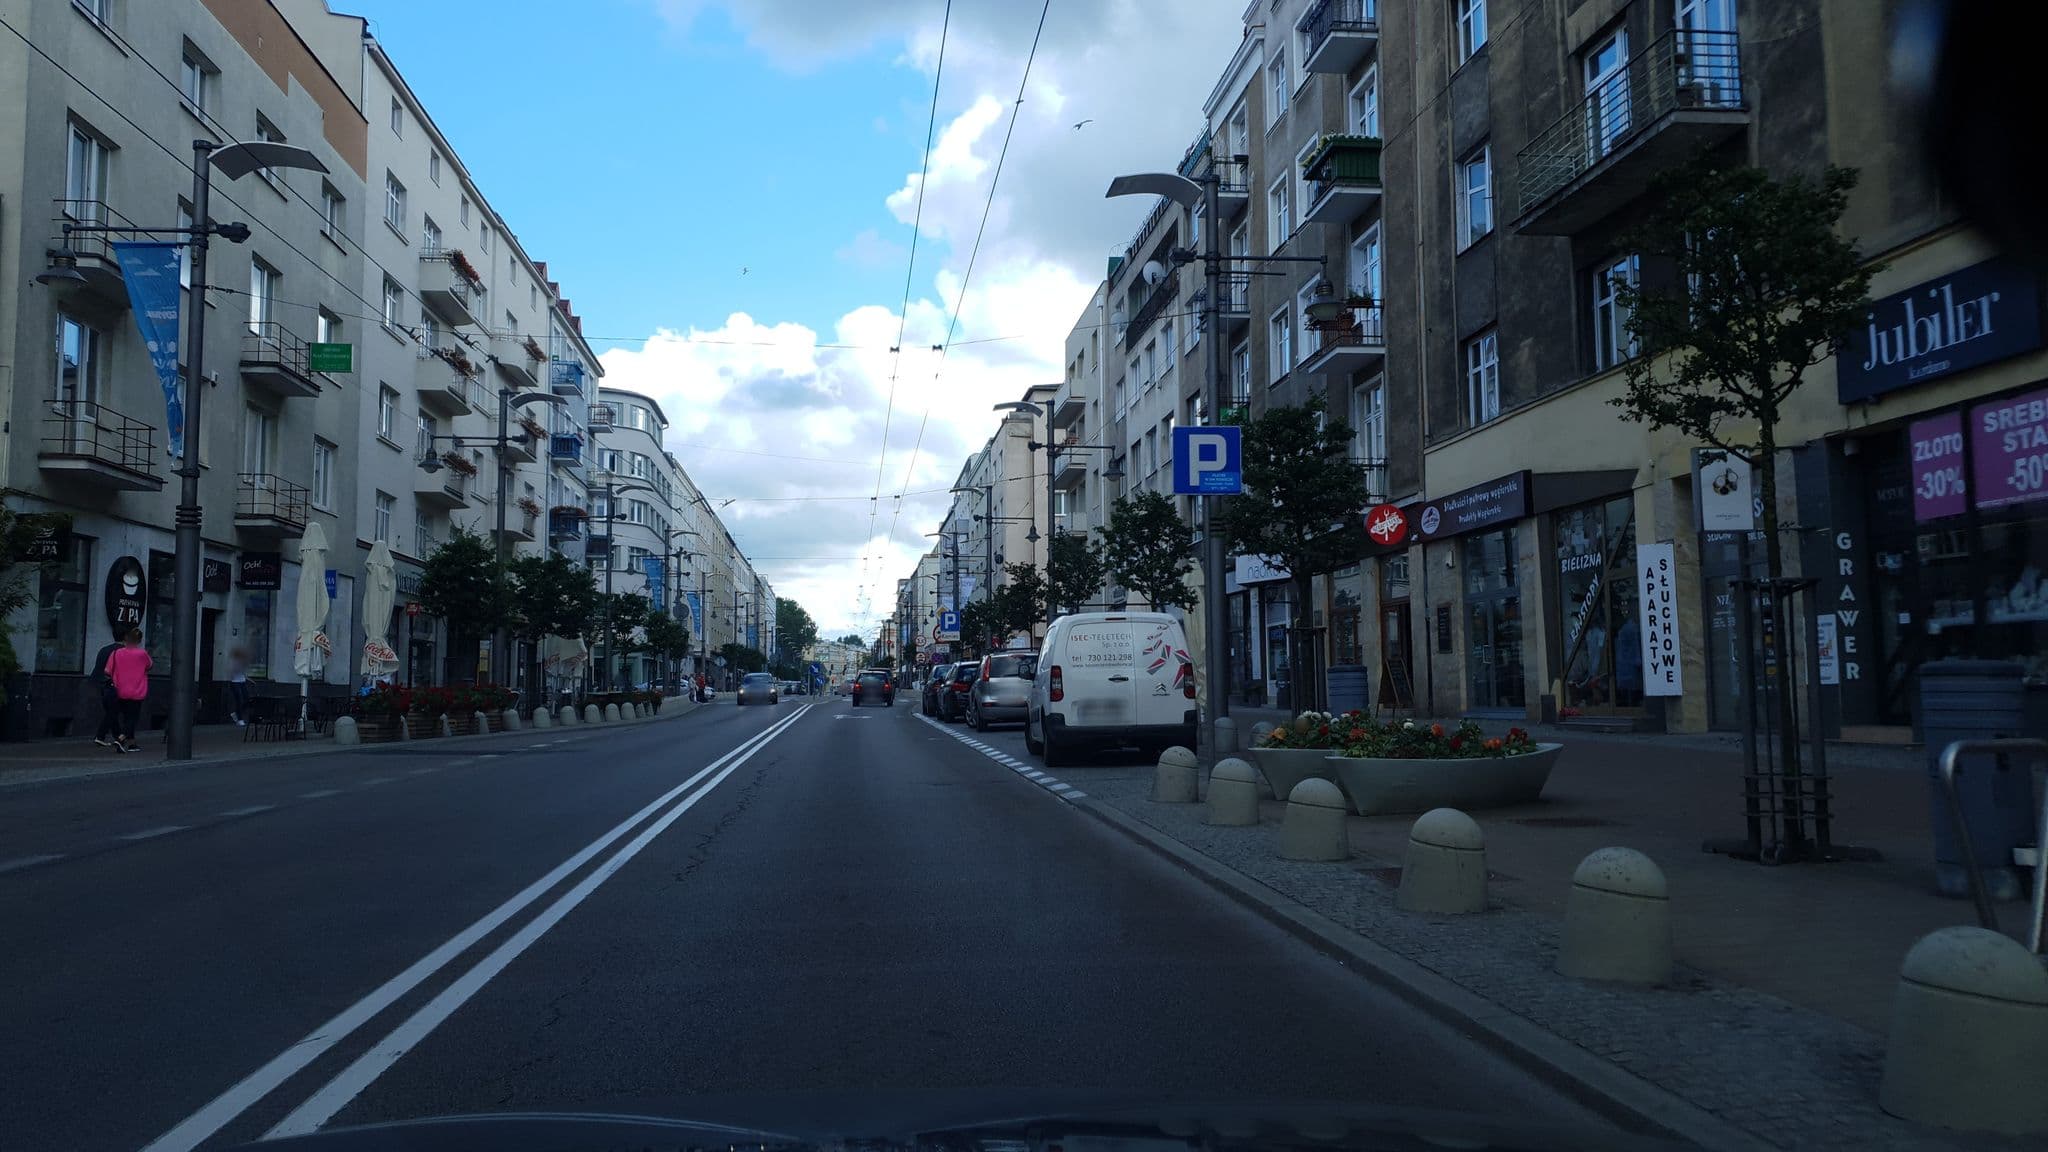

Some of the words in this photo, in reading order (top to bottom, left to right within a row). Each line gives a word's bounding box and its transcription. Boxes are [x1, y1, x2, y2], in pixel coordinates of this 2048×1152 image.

[1984, 398, 2048, 432] SREB
[1188, 434, 1226, 486] P
[1917, 466, 1966, 499] -30%
[26, 545, 58, 556] ZPA
[1561, 552, 1602, 573] BIELIZNA
[117, 606, 140, 623] ZPA
[945, 614, 956, 629] P
[1646, 567, 1659, 675] APARATY
[1659, 559, 1675, 683] SŁUCHOWE
[1836, 532, 1860, 680] GRAWER
[1118, 653, 1132, 661] 298
